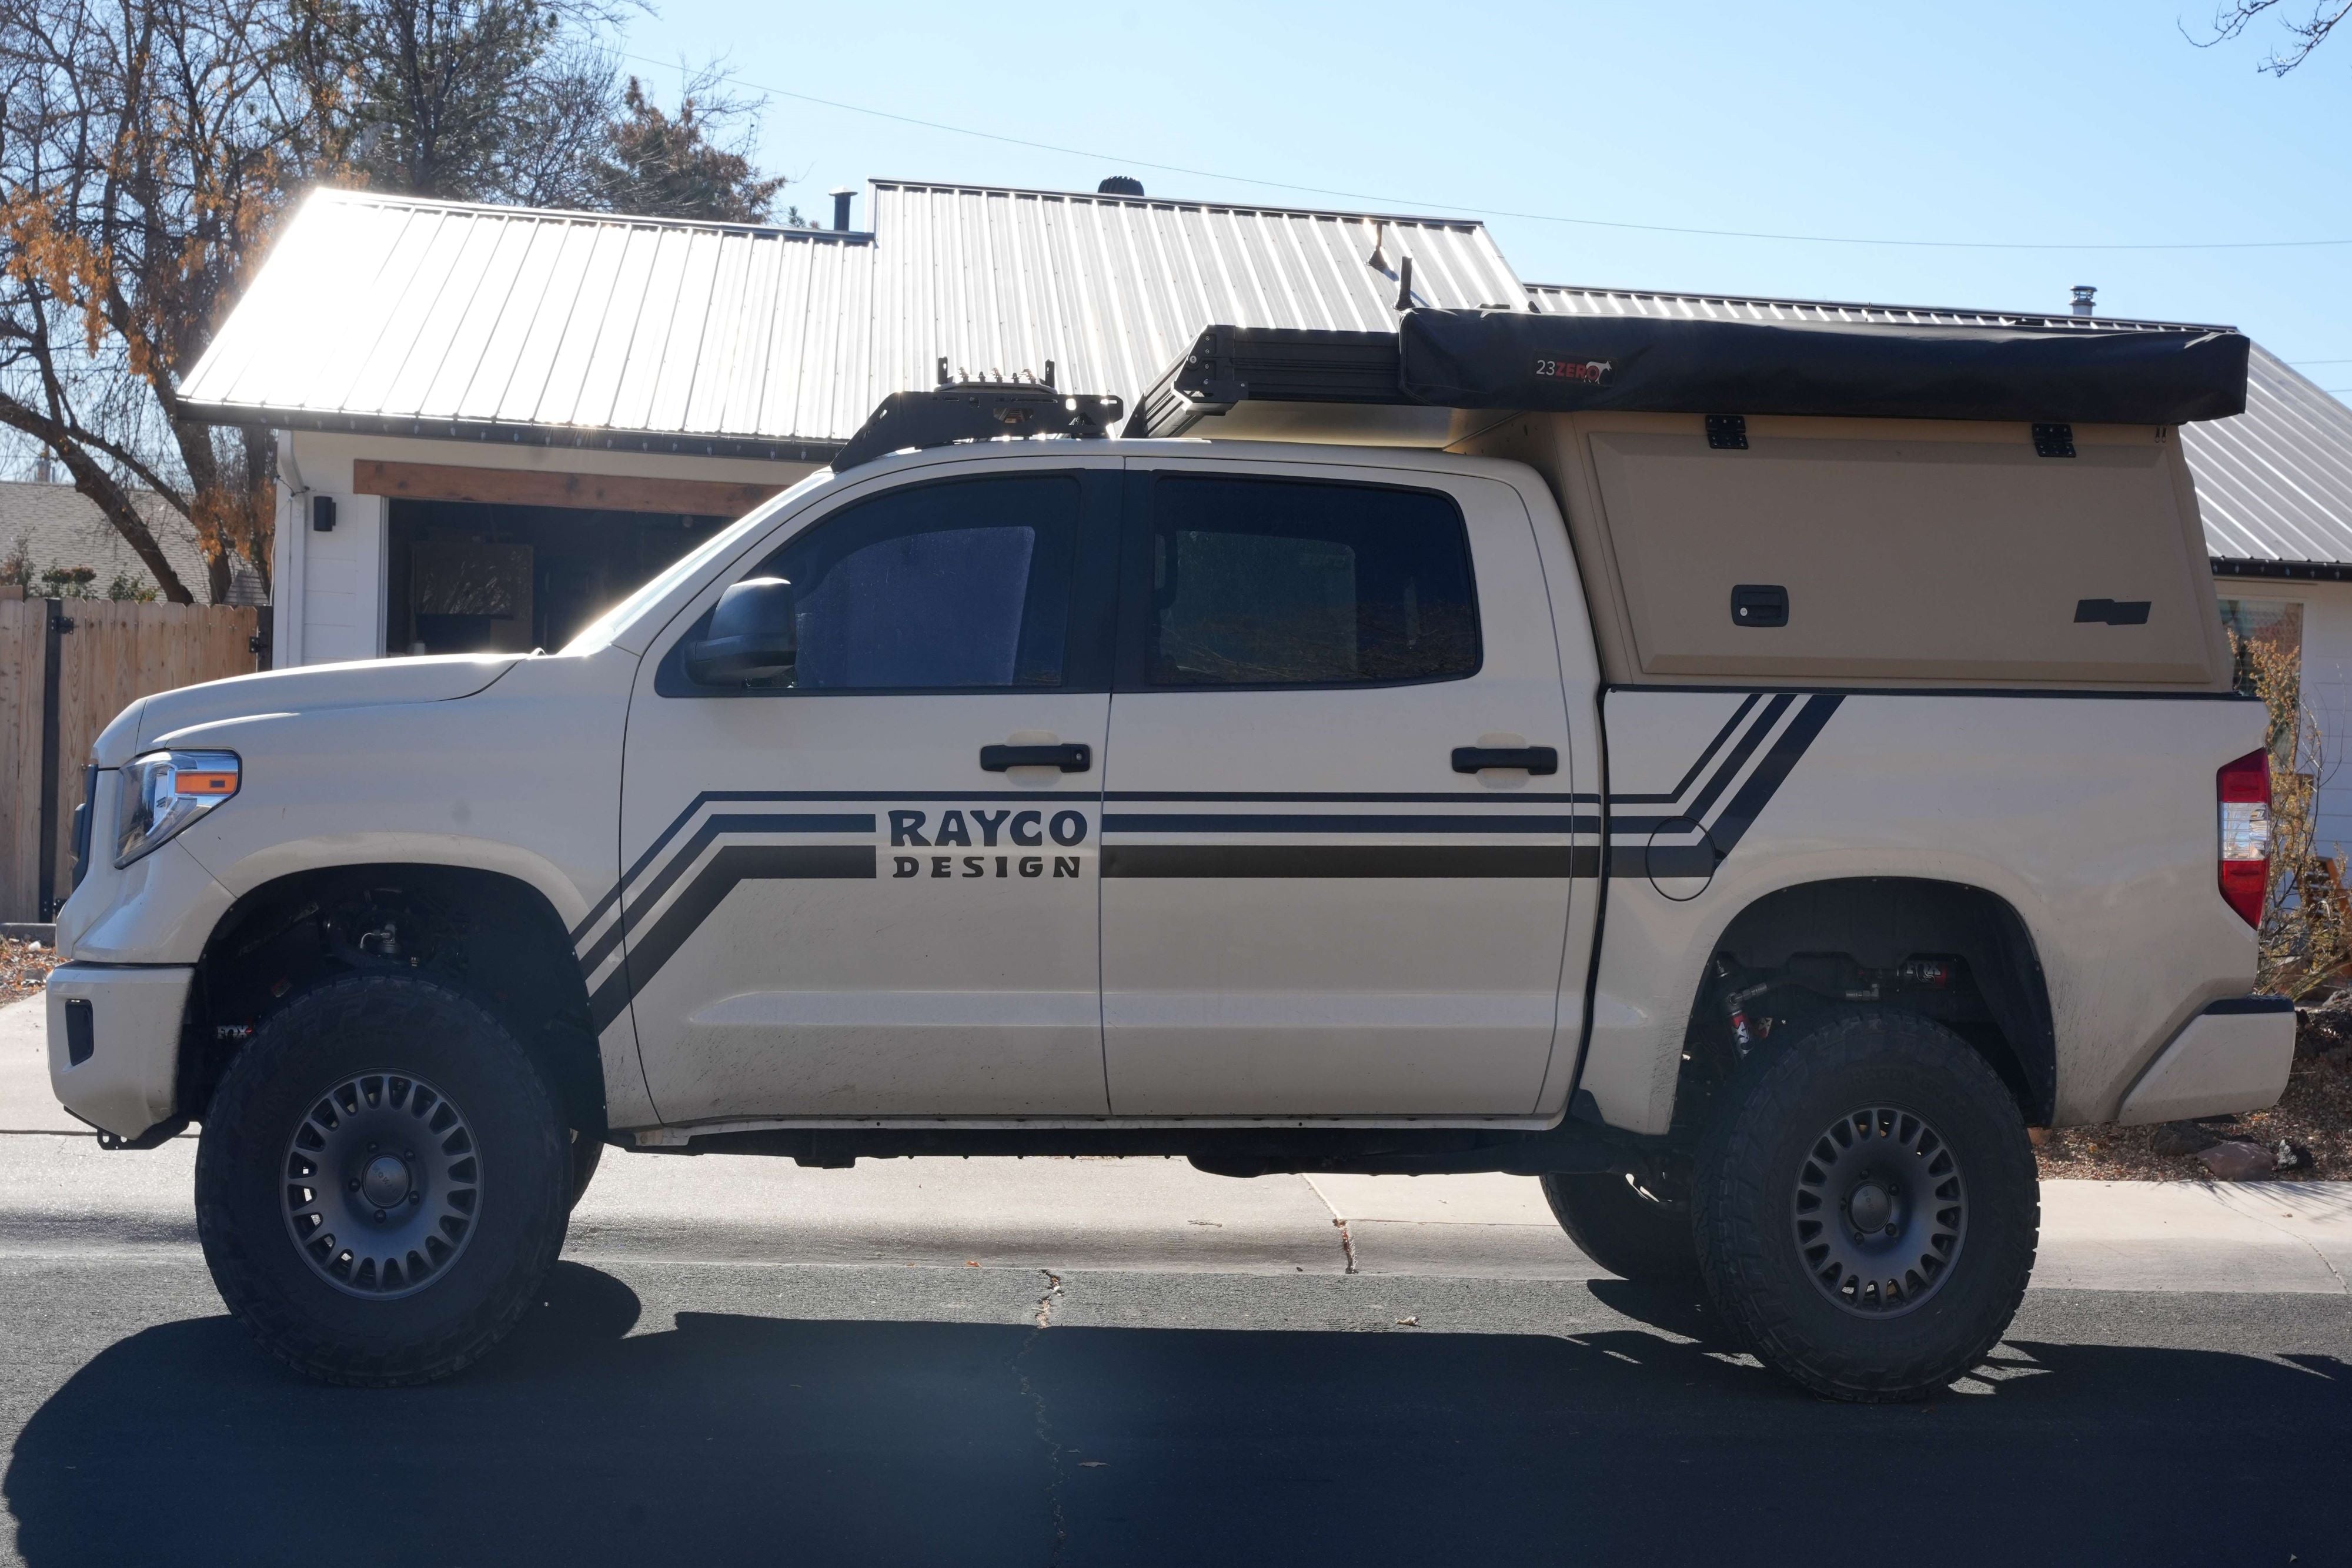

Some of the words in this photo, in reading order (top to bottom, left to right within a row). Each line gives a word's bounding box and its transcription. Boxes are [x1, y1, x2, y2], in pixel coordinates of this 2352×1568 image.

[1536, 360, 1599, 381] 23ZERO
[888, 810, 1087, 847] RAYCO
[893, 856, 1080, 878] DESIGN
[216, 1025, 249, 1039] FOX
